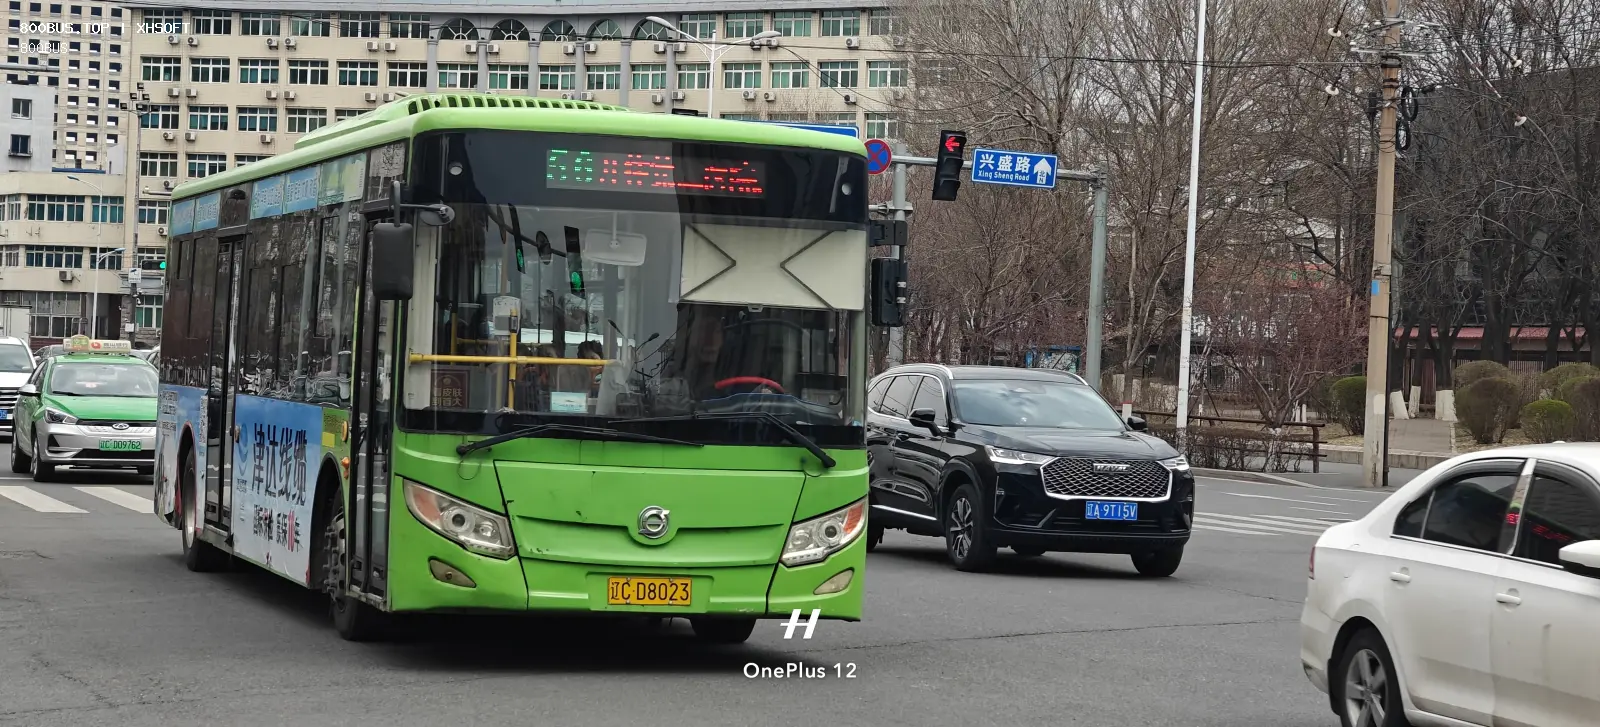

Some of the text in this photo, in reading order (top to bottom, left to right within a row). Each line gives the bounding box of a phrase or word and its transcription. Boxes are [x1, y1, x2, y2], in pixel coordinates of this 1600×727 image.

[979, 153, 1031, 173] 兴盛路
[977, 170, 1030, 181] Xing Sheng Road
